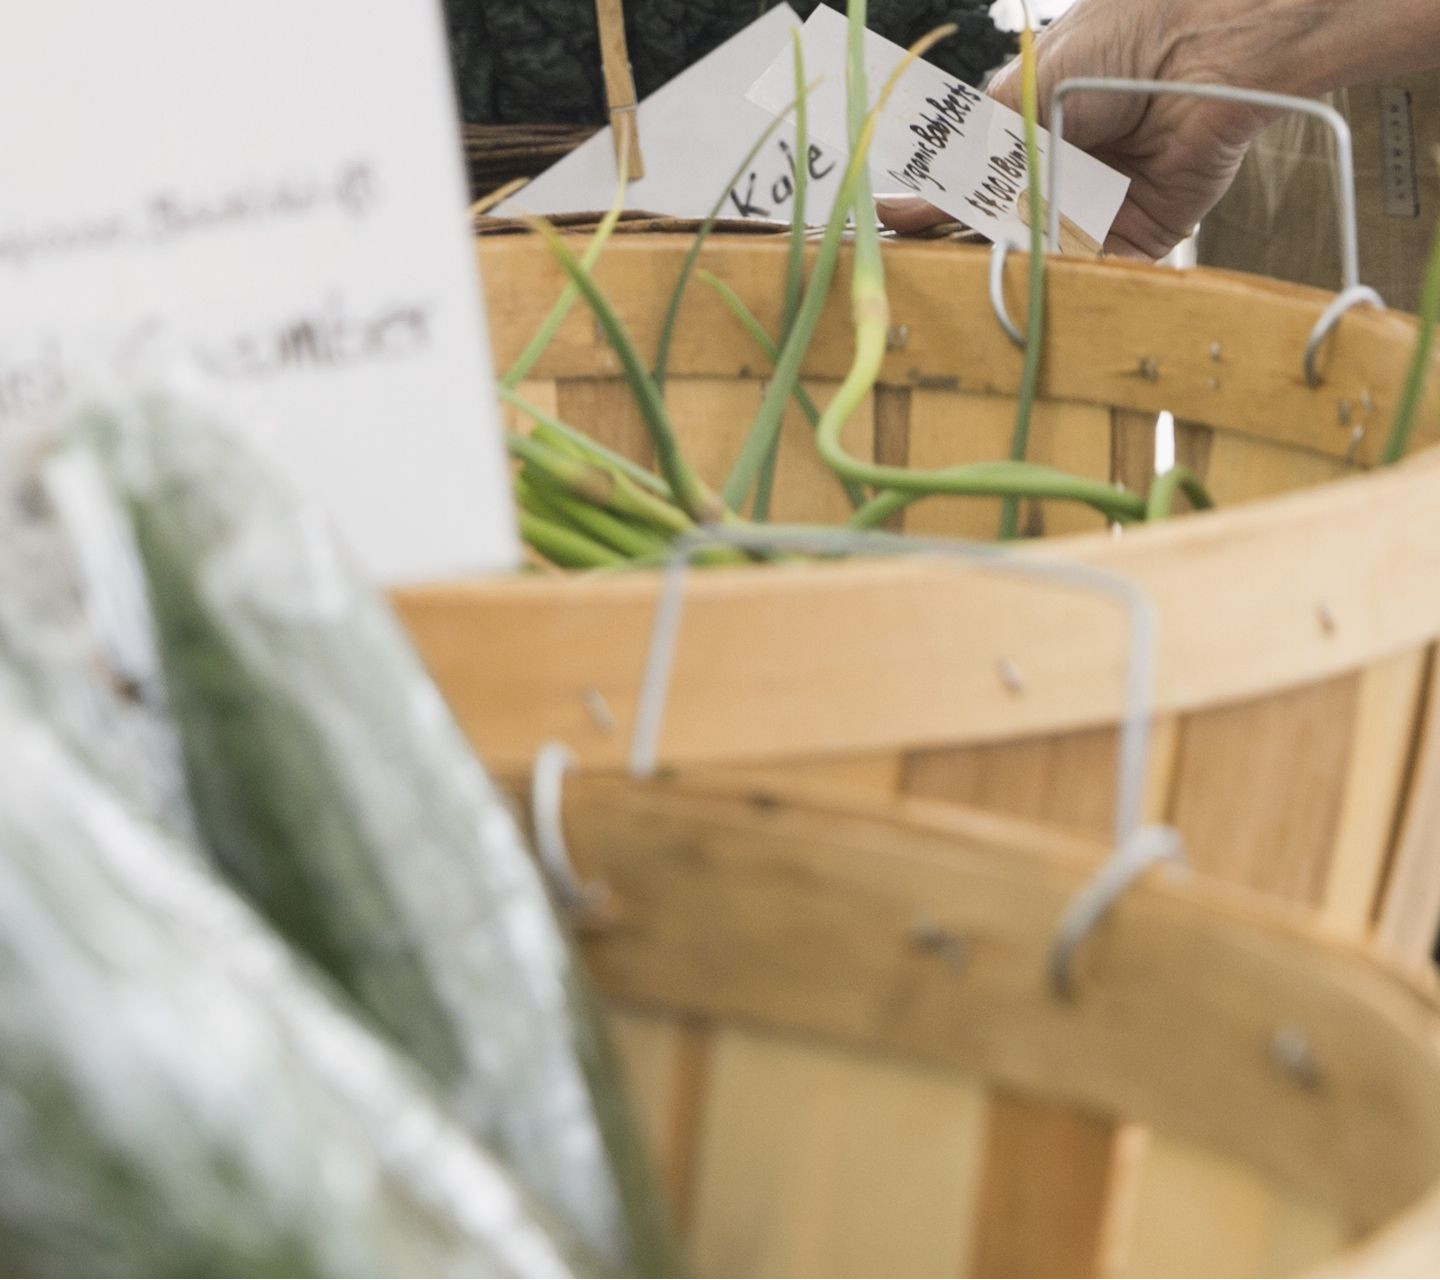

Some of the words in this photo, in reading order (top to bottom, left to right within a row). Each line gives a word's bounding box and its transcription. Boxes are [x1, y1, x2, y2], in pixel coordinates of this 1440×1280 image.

[925, 81, 982, 125] Beets
[909, 112, 965, 149] Baby
[729, 139, 838, 218] Kale
[887, 141, 947, 192] Organic
